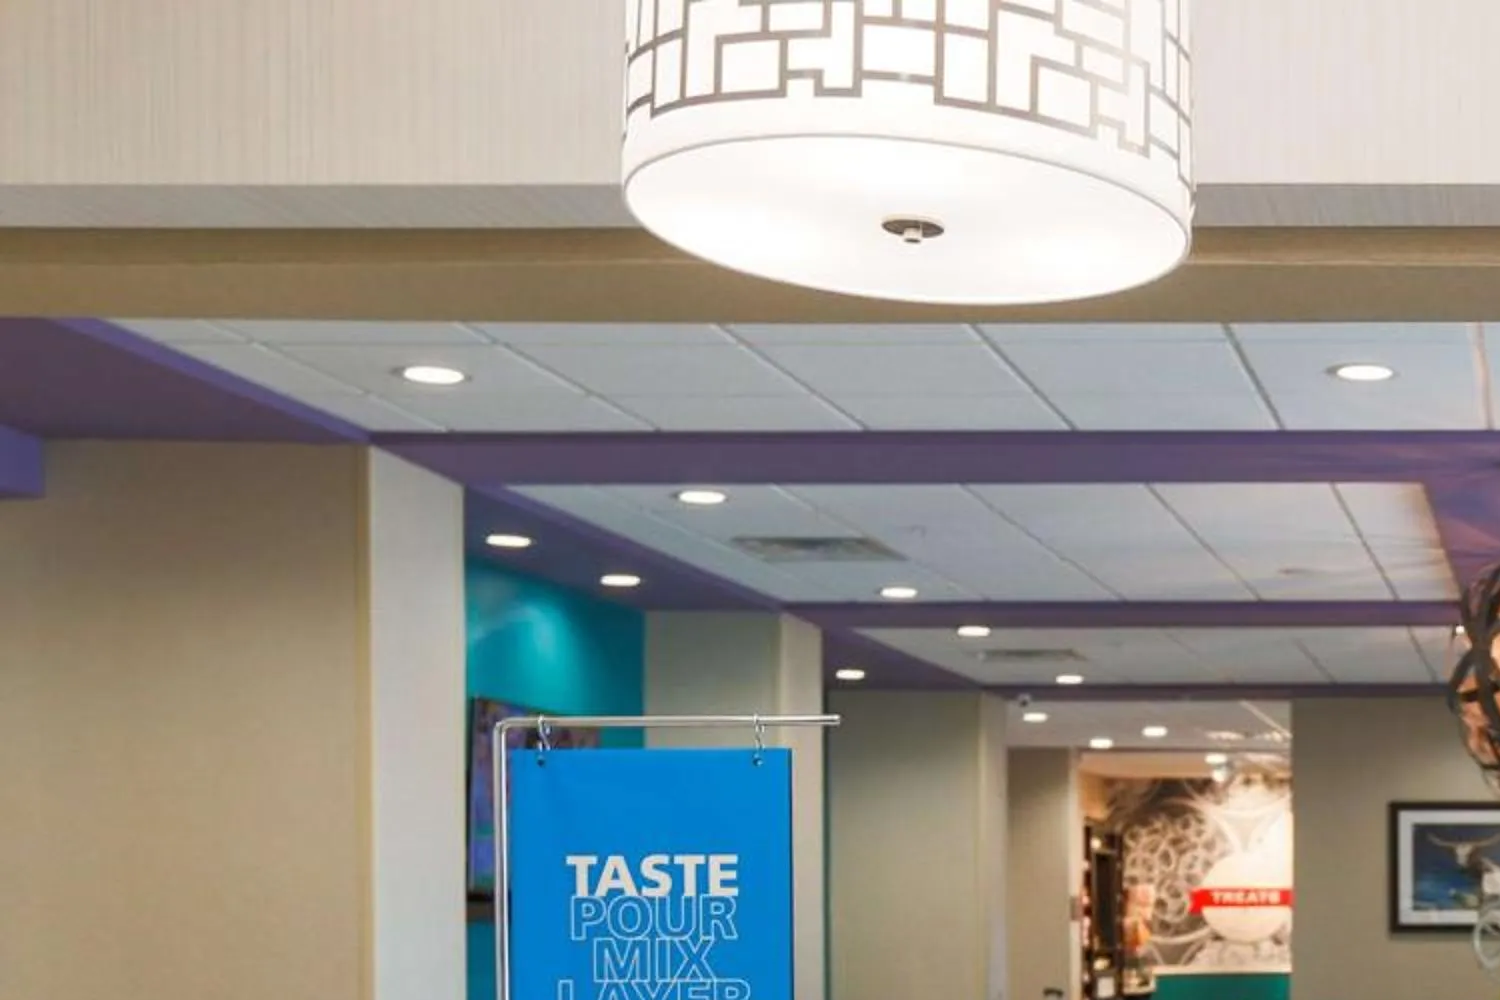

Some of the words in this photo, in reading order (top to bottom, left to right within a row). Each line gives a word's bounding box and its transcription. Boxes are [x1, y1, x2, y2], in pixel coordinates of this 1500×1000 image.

[565, 854, 739, 898] TASTE
[1211, 890, 1281, 906] TREATS
[570, 895, 738, 940] POUR
[593, 937, 716, 983] MIX
